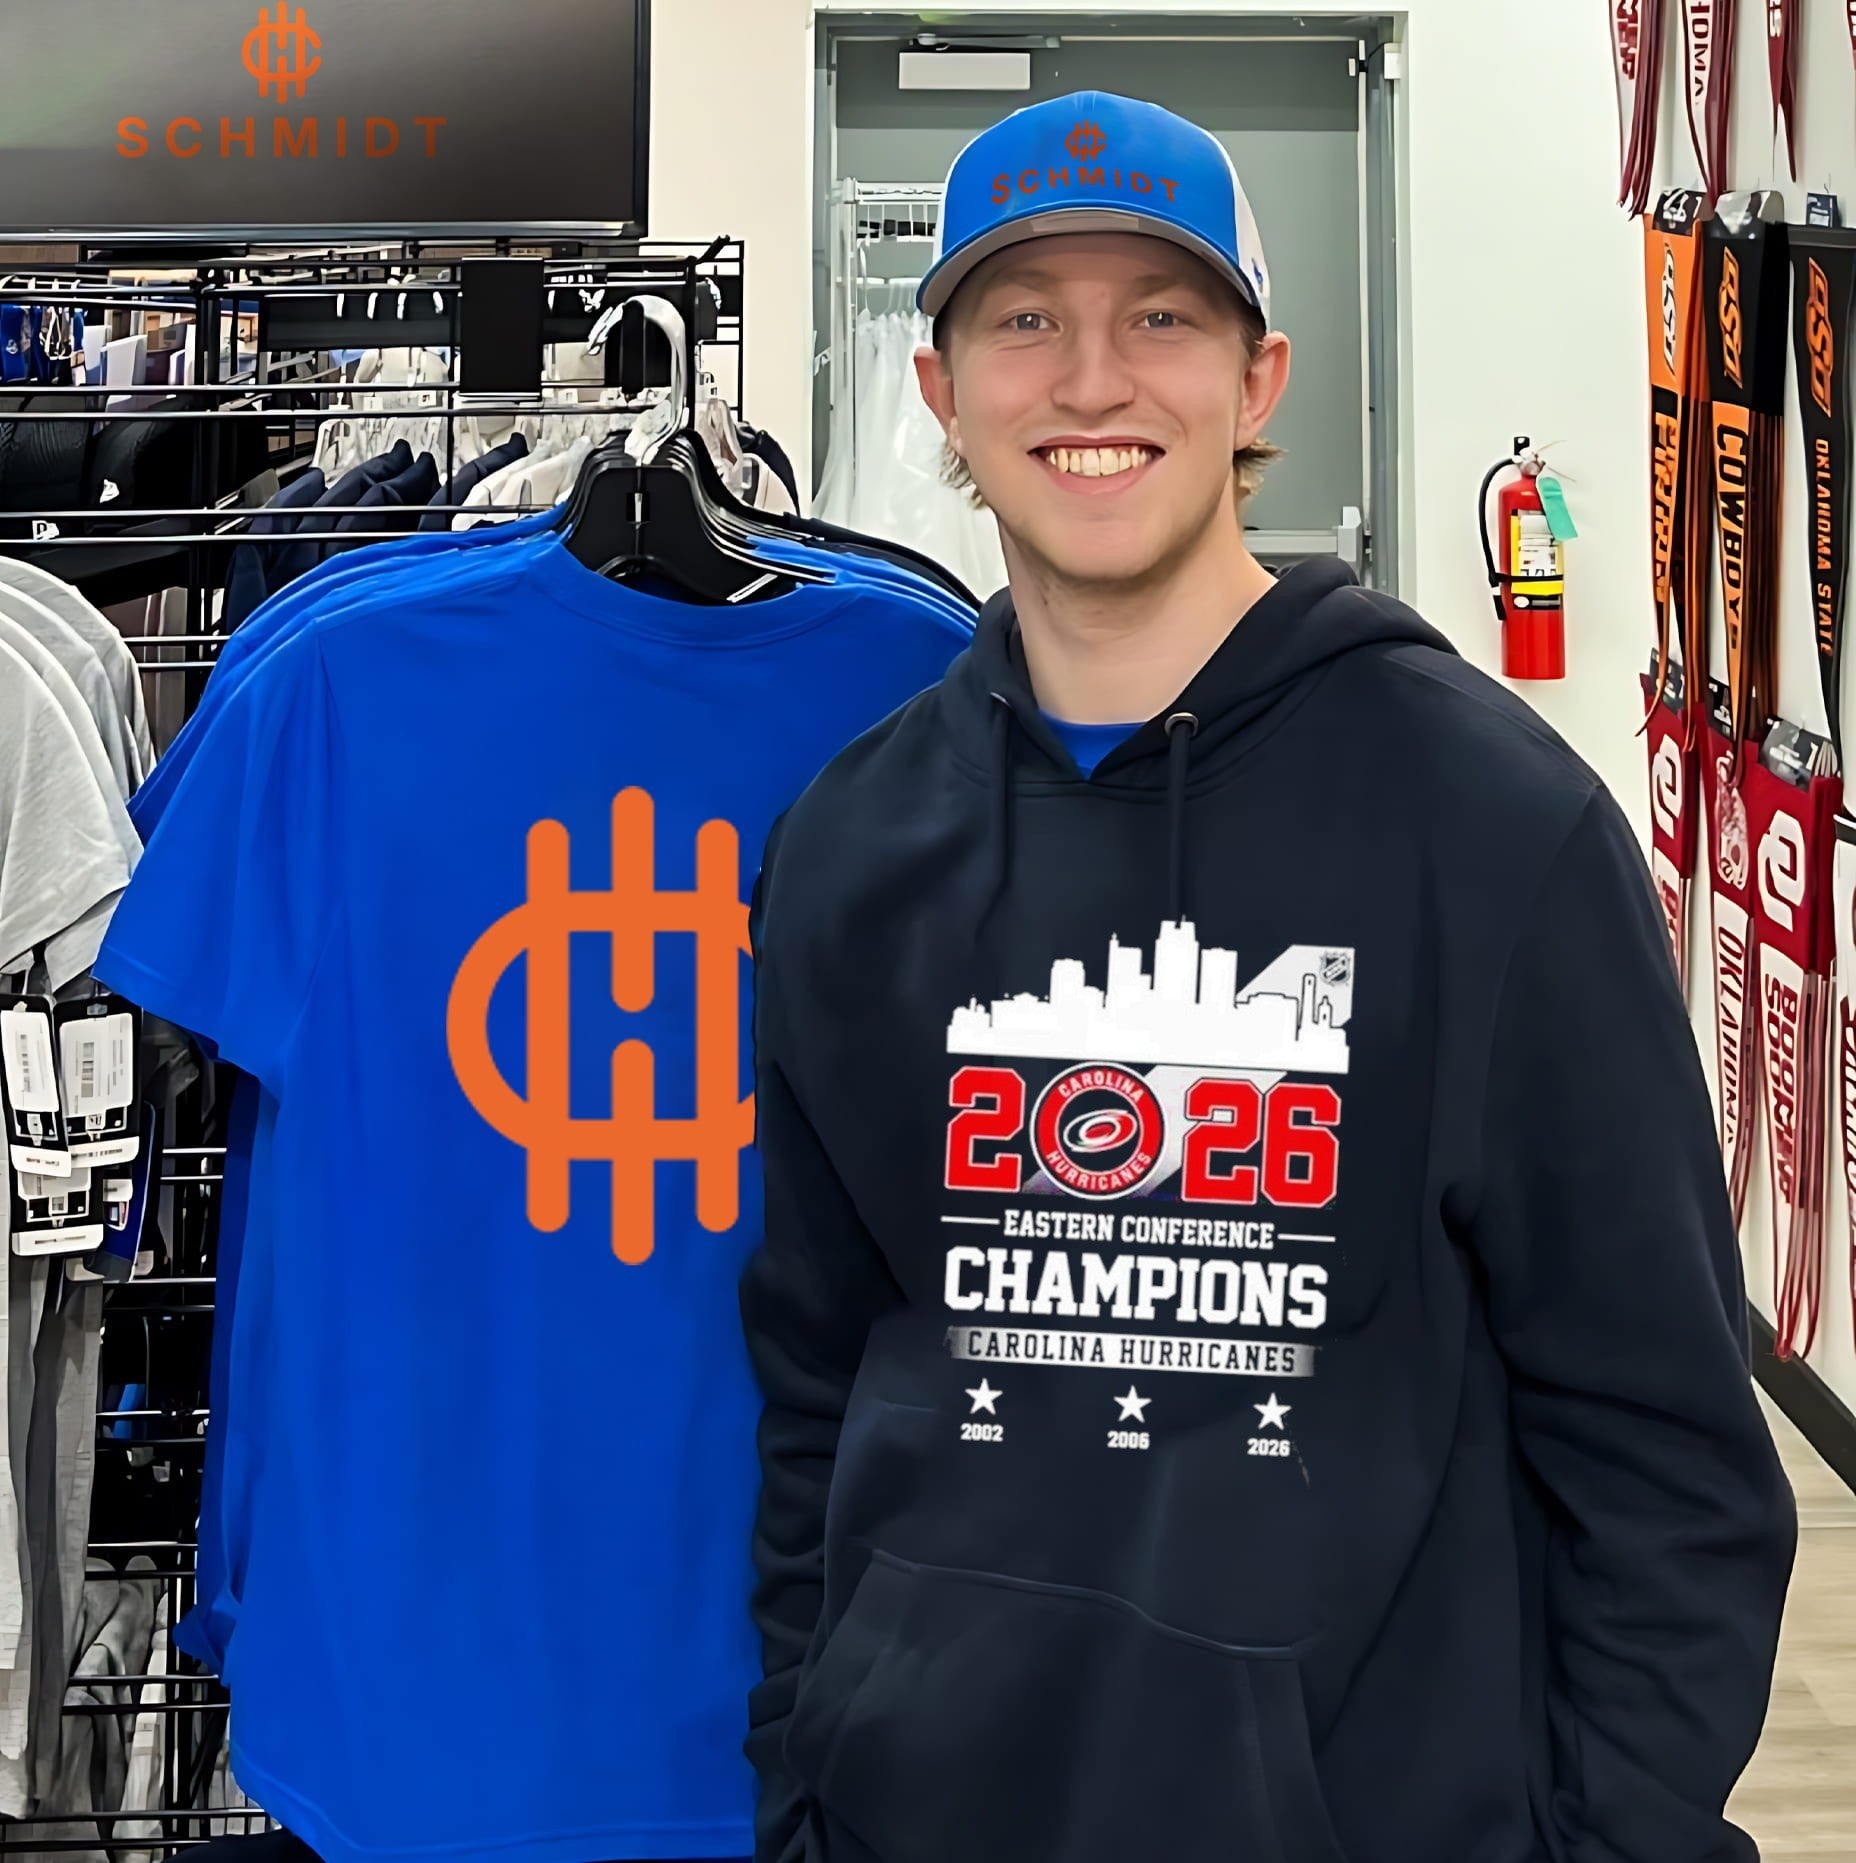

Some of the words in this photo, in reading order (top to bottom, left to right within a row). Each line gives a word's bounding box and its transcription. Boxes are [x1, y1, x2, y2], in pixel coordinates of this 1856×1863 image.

[116, 117, 447, 158] SCHMIDT
[991, 167, 1179, 204] SCHMIDT
[1718, 926, 1745, 1144] OKLAHOMA
[1058, 1070, 1144, 1103] CAROLINA
[1046, 1150, 1151, 1191] HURRICANES
[1004, 1208, 1115, 1241] EASTERN
[1121, 1215, 1274, 1249] CONFERENCE
[944, 1246, 1328, 1329] CHAMPIONS
[968, 1331, 1104, 1363] CAROLINA
[1120, 1339, 1296, 1373] HURRICANES
[960, 1423, 1003, 1442] 2002
[1107, 1430, 1150, 1450] 2006
[1247, 1437, 1290, 1457] 2026
